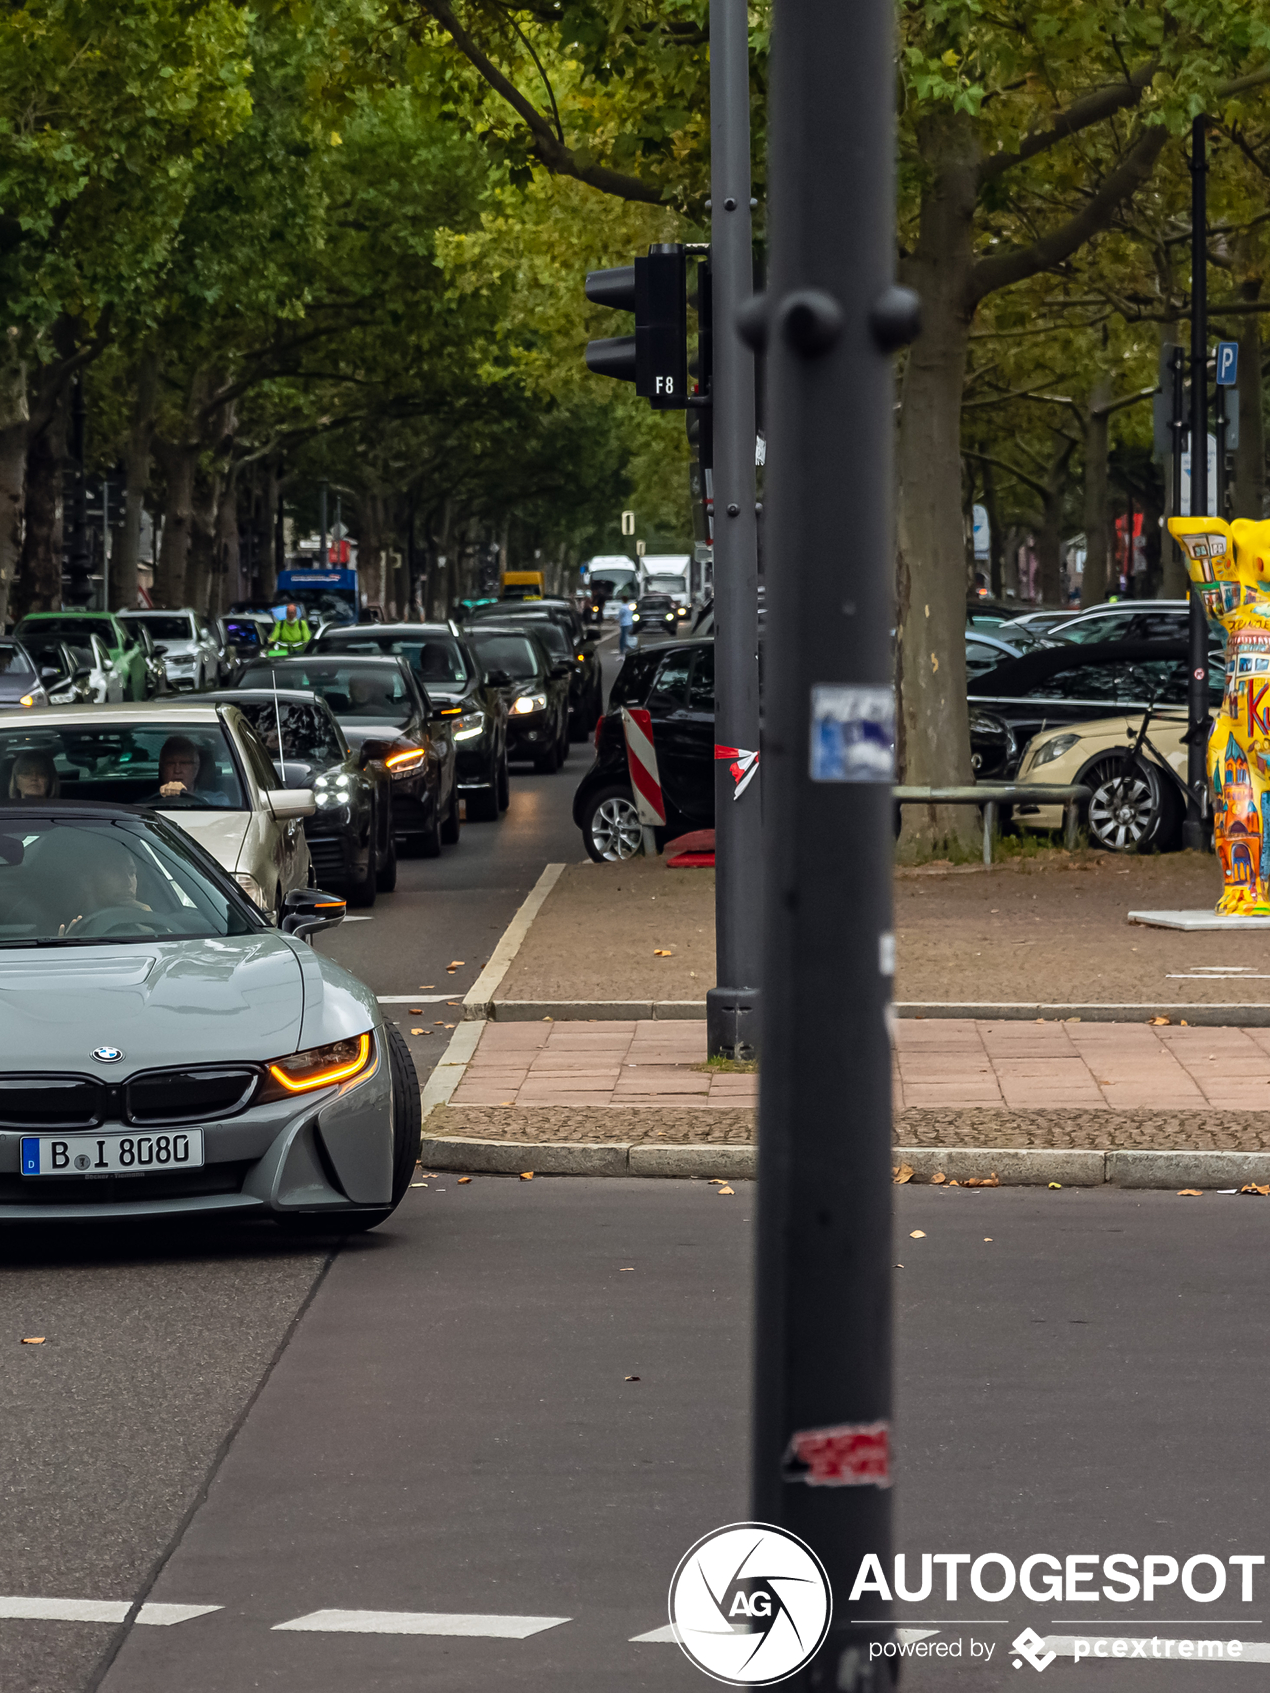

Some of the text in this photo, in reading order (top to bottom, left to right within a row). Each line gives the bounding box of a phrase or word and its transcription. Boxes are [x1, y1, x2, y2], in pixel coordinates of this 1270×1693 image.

[1221, 348, 1234, 379] P
[655, 376, 674, 394] F8
[51, 1134, 190, 1169] B I 8080
[28, 1160, 35, 1169] D
